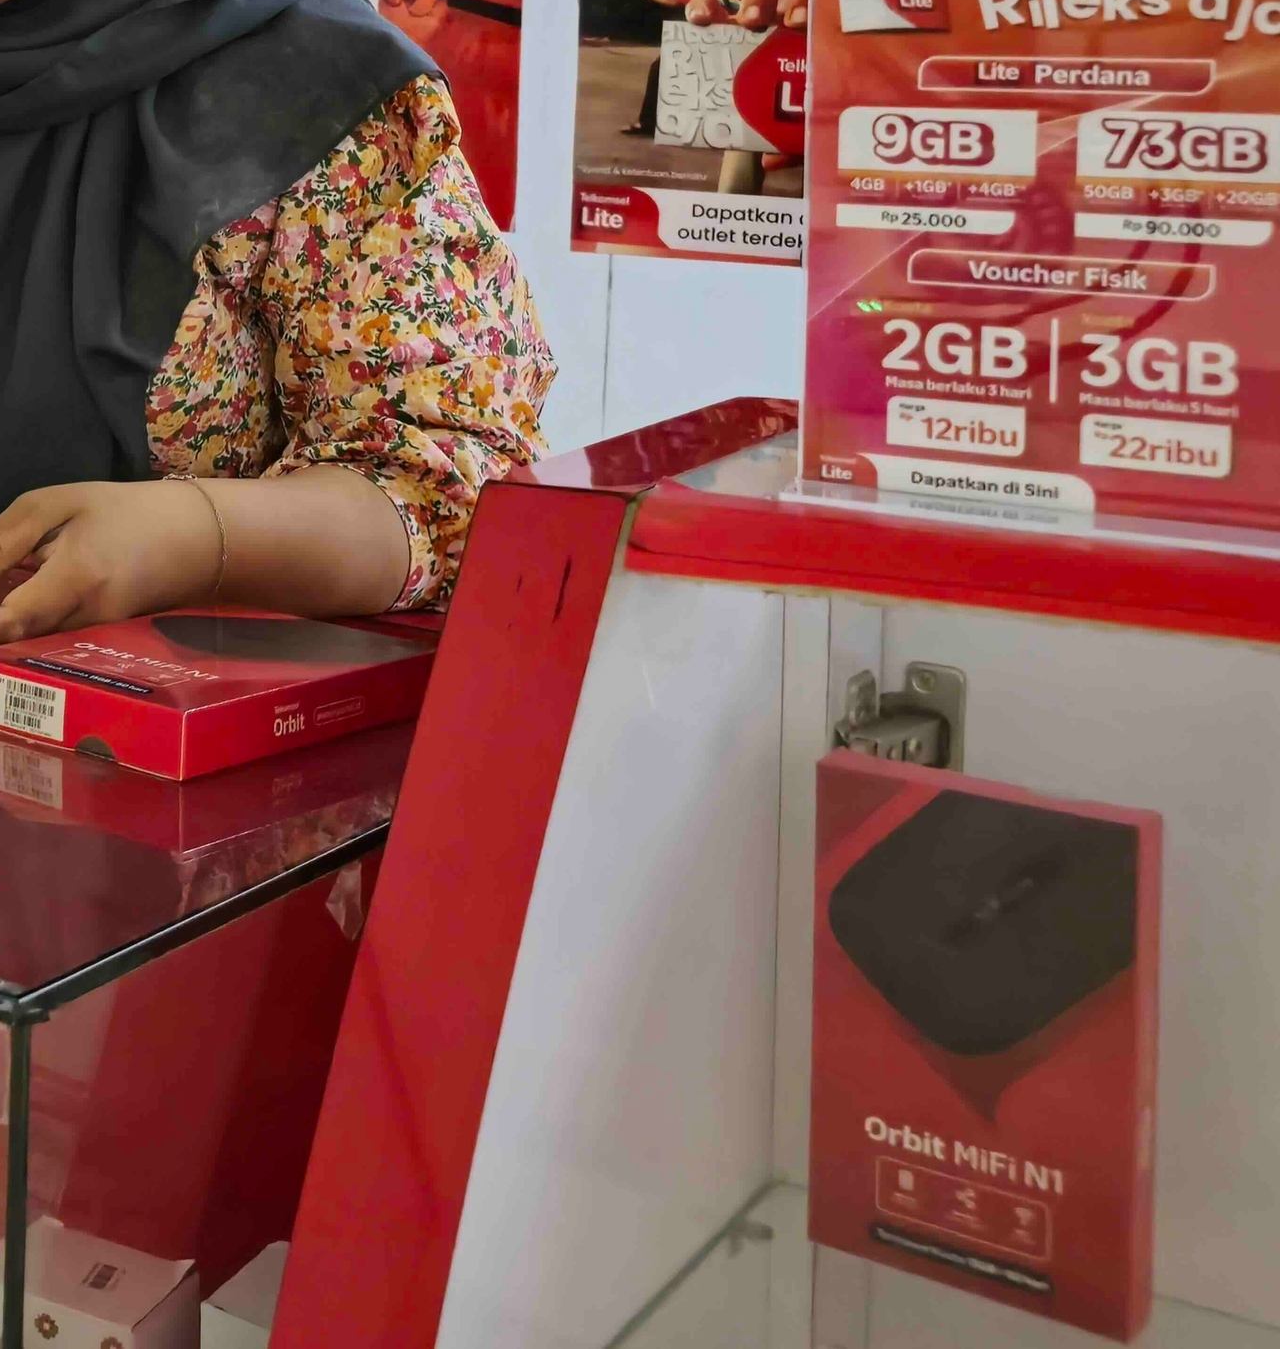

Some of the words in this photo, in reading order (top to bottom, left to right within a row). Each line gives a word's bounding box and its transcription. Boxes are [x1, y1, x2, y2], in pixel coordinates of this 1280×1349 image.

[978, 62, 1019, 81] Lite
[1035, 63, 1151, 86] Perdana
[874, 115, 984, 160] 9GB
[1103, 119, 1266, 169] 73GB
[851, 176, 885, 192] 4GB
[582, 207, 624, 230] Lite
[692, 204, 792, 228] Dapatkan
[901, 212, 966, 228] 25.000
[1145, 221, 1221, 238] 90.000
[678, 225, 735, 244] outlet
[969, 260, 1080, 285] Voucher
[1085, 267, 1146, 291] Fisik
[881, 320, 1028, 379] 2GB
[1081, 334, 1239, 396] 3GB
[920, 417, 1018, 448] 12ribu
[1110, 436, 1217, 467] 22ribu
[821, 465, 852, 480] Lite
[911, 470, 998, 495] Dapatkan
[1003, 480, 1019, 495] di
[1024, 483, 1059, 498] Sini
[73, 642, 136, 660] Orbit
[189, 670, 219, 680] N1
[274, 714, 305, 737] Orbit
[864, 1115, 945, 1160] Orbit
[1024, 1161, 1064, 1194] N1
